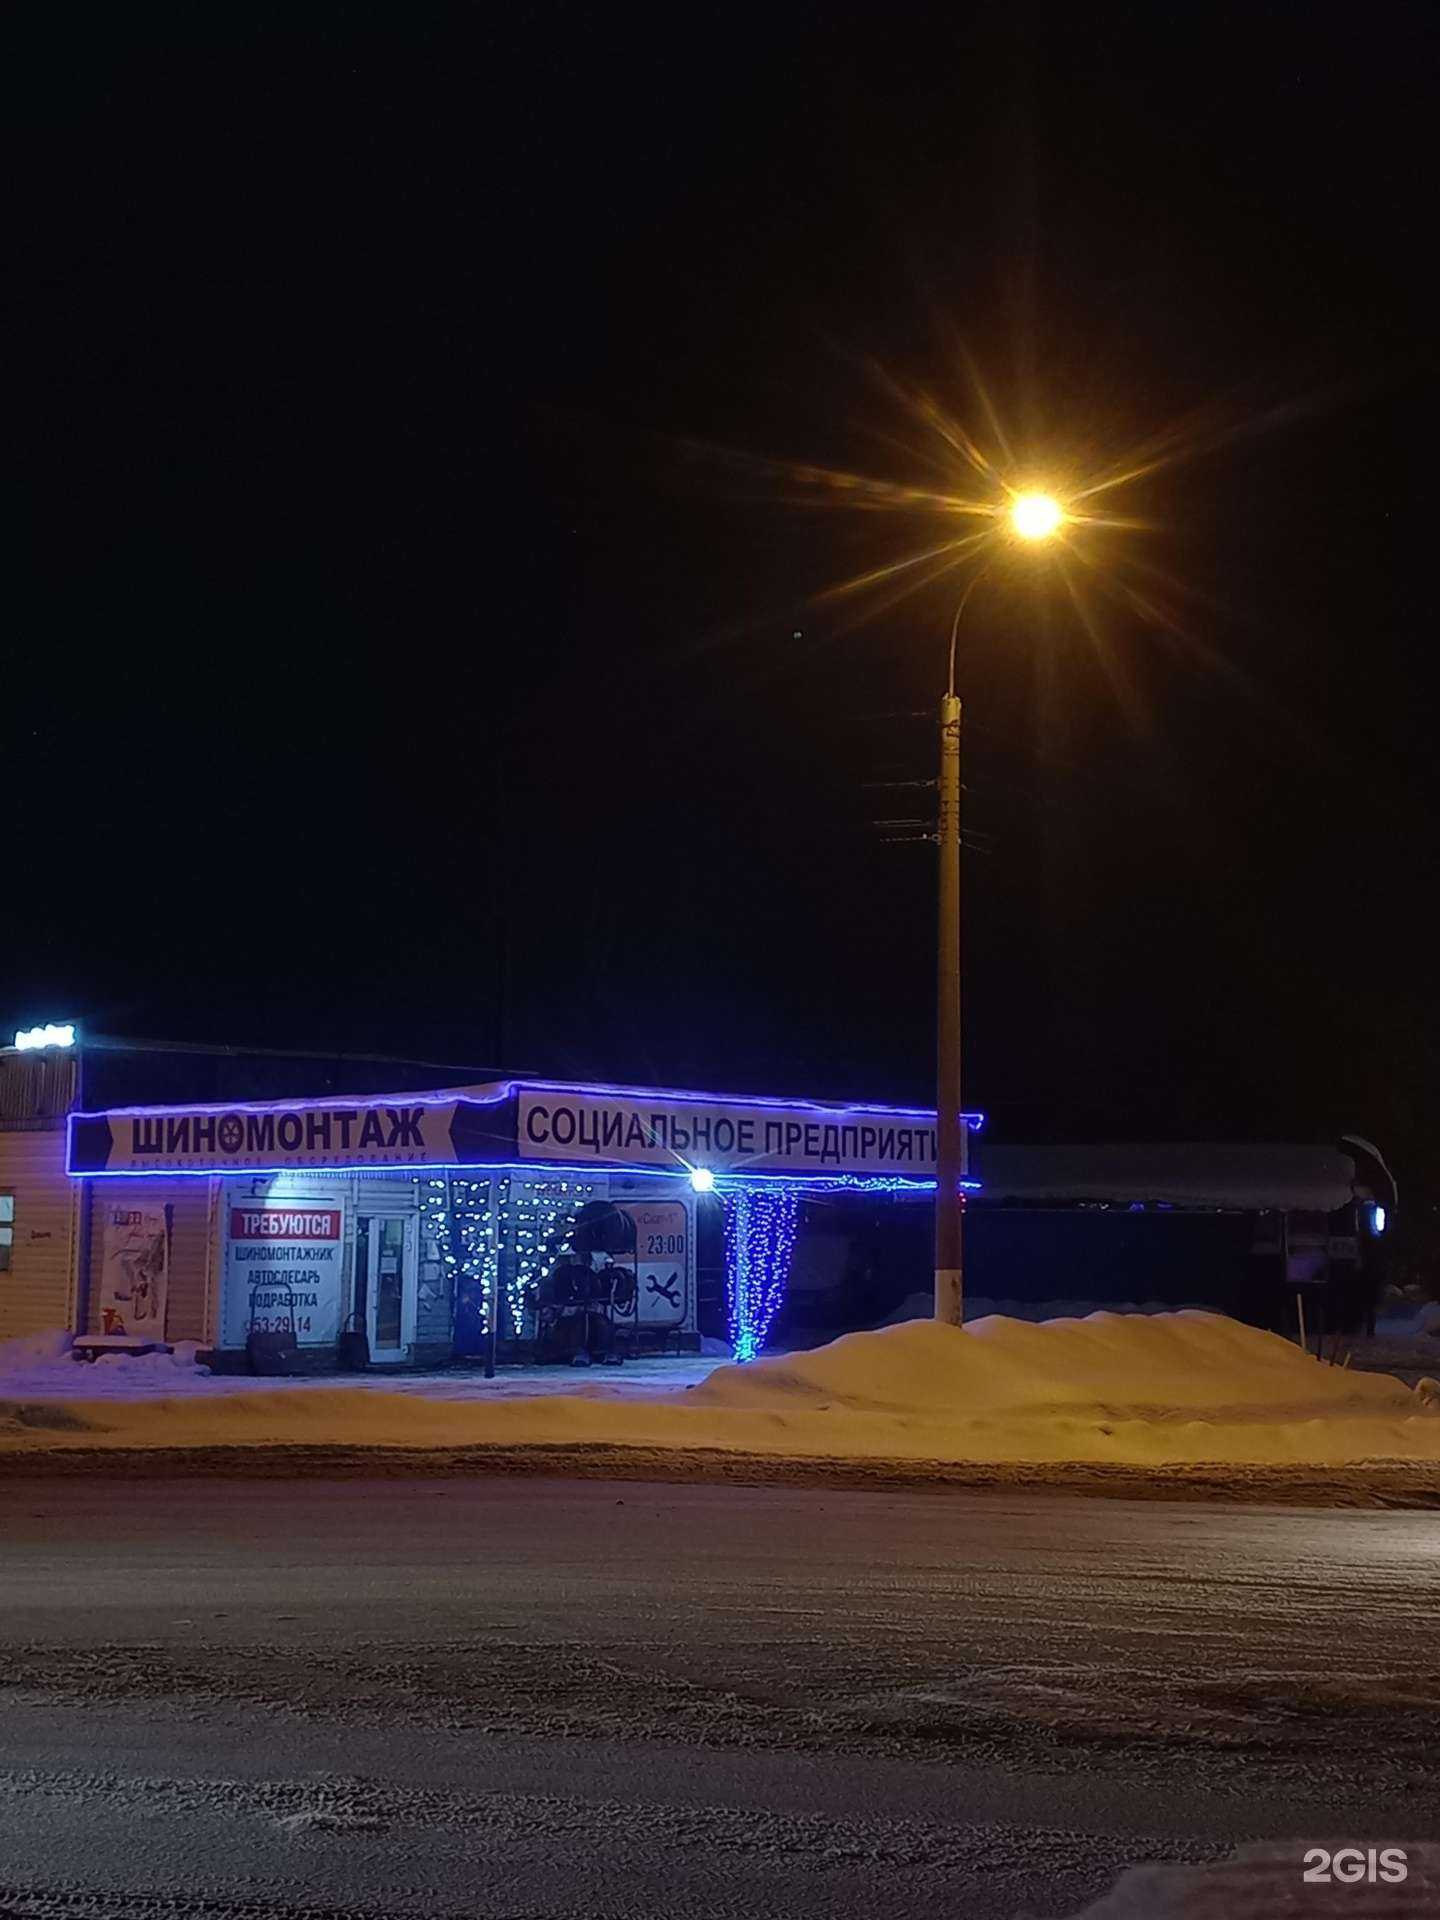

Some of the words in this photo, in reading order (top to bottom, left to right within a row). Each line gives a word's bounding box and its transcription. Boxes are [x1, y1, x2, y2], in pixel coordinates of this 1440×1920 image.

[132, 1107, 424, 1154] ШИНОМОНТАЖ
[526, 1106, 755, 1152] СОЦИАЛЬНОЕ
[242, 1213, 332, 1236] ТРЕБУЮТСЯ
[235, 1246, 334, 1261] ШИНОМОНТАЖНИК
[647, 1234, 685, 1255] 23:00
[247, 1269, 320, 1284] АВТОСЛЕСАРЬ
[248, 1293, 318, 1309] ПОДРАБОТКА
